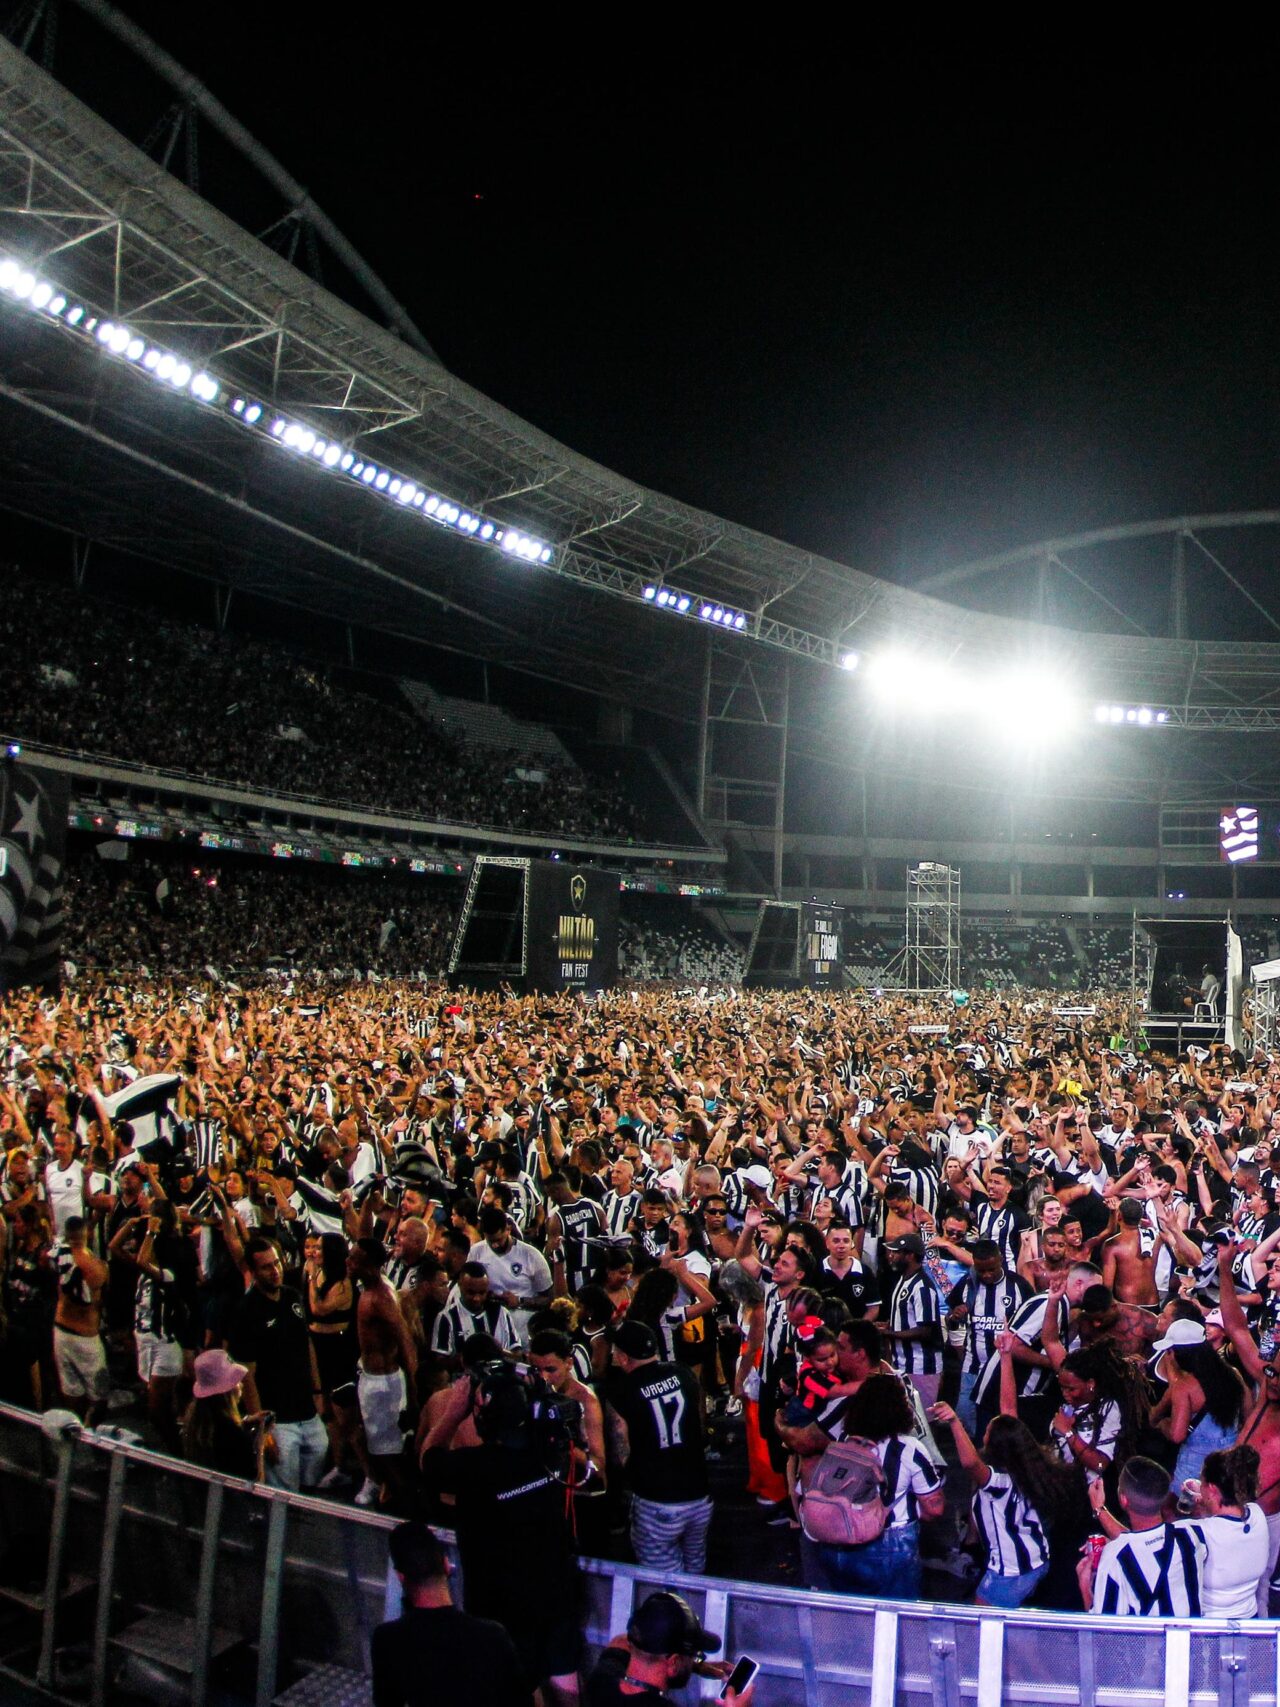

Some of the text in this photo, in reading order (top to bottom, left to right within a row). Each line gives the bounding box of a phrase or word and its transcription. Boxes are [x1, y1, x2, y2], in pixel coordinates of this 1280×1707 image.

[561, 963, 589, 978] FAN FEST
[640, 1375, 681, 1398] WAGNER
[650, 1389, 685, 1449] 17
